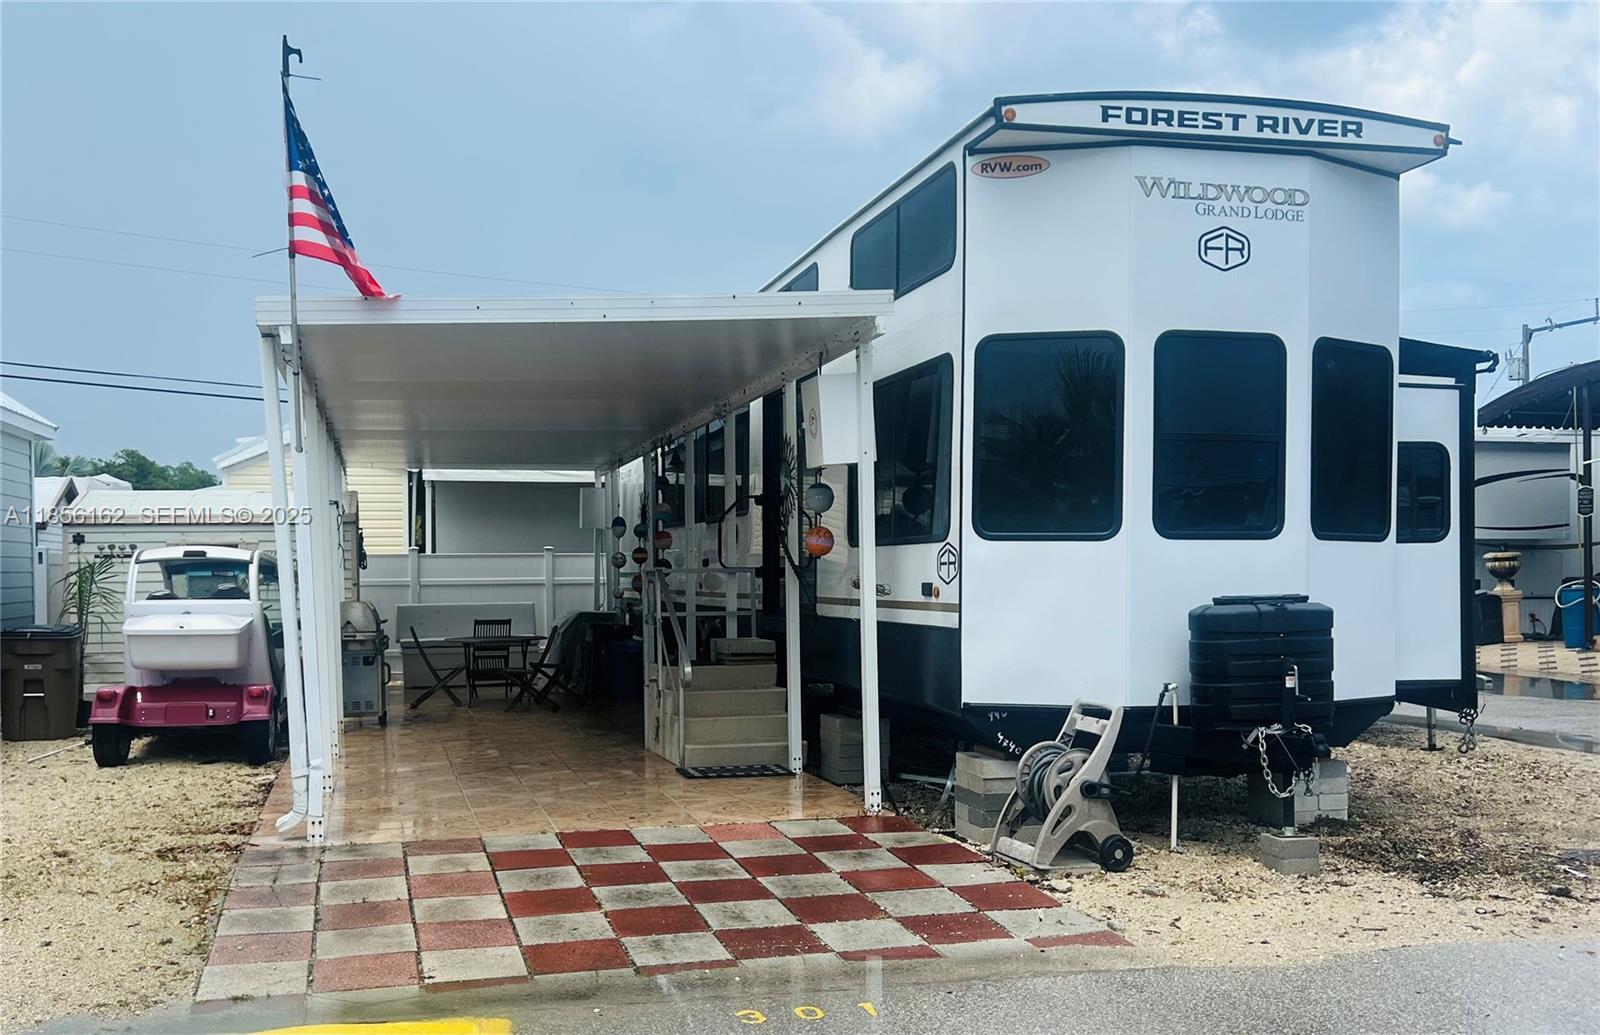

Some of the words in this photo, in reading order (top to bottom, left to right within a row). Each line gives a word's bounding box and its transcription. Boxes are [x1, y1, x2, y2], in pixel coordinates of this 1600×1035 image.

[1100, 104, 1247, 131] FOREST
[1255, 115, 1364, 139] RIVER
[980, 161, 1042, 174] RVW.com
